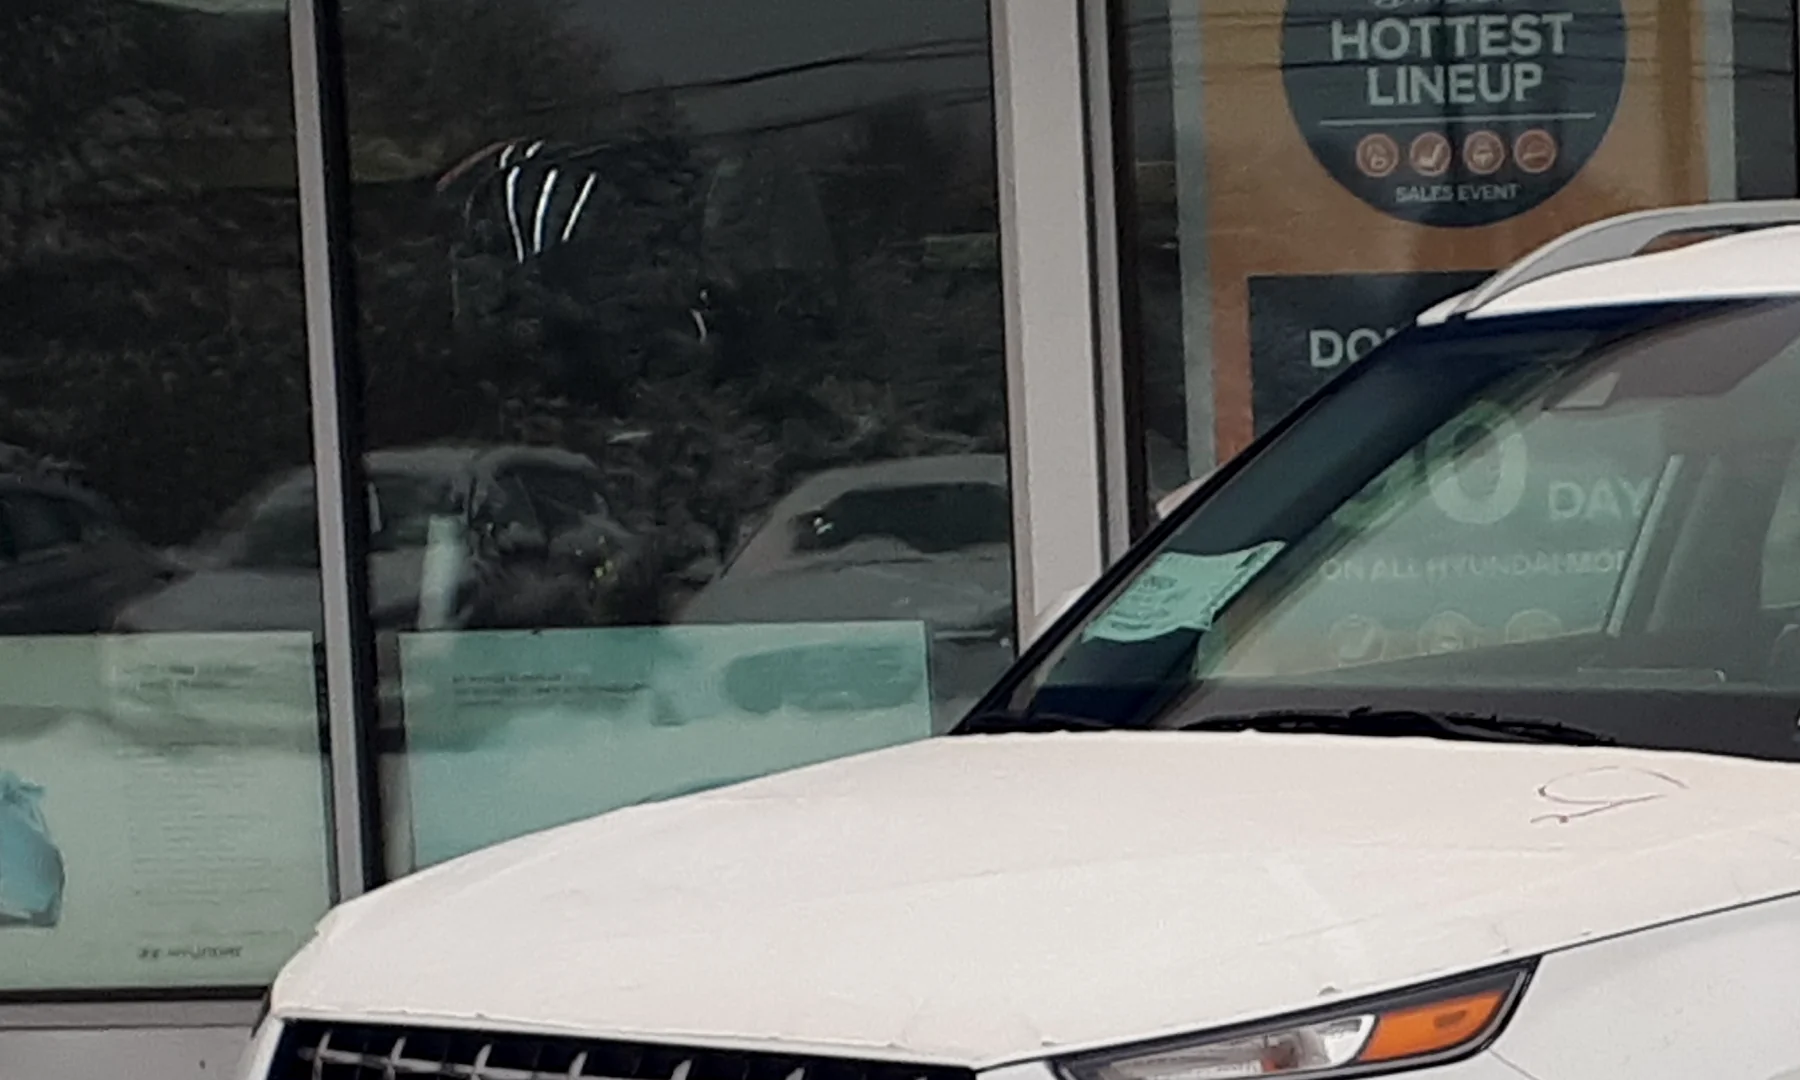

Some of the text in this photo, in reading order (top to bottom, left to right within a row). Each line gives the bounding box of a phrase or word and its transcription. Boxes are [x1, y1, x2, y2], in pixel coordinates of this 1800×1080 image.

[1331, 13, 1574, 60] HOTTEST
[1367, 62, 1544, 106] LINEUP
[1395, 182, 1521, 202] SALES EVENT
[1309, 327, 1397, 367] DO
[1323, 557, 1364, 583] ON
[1370, 557, 1420, 582] ALL
